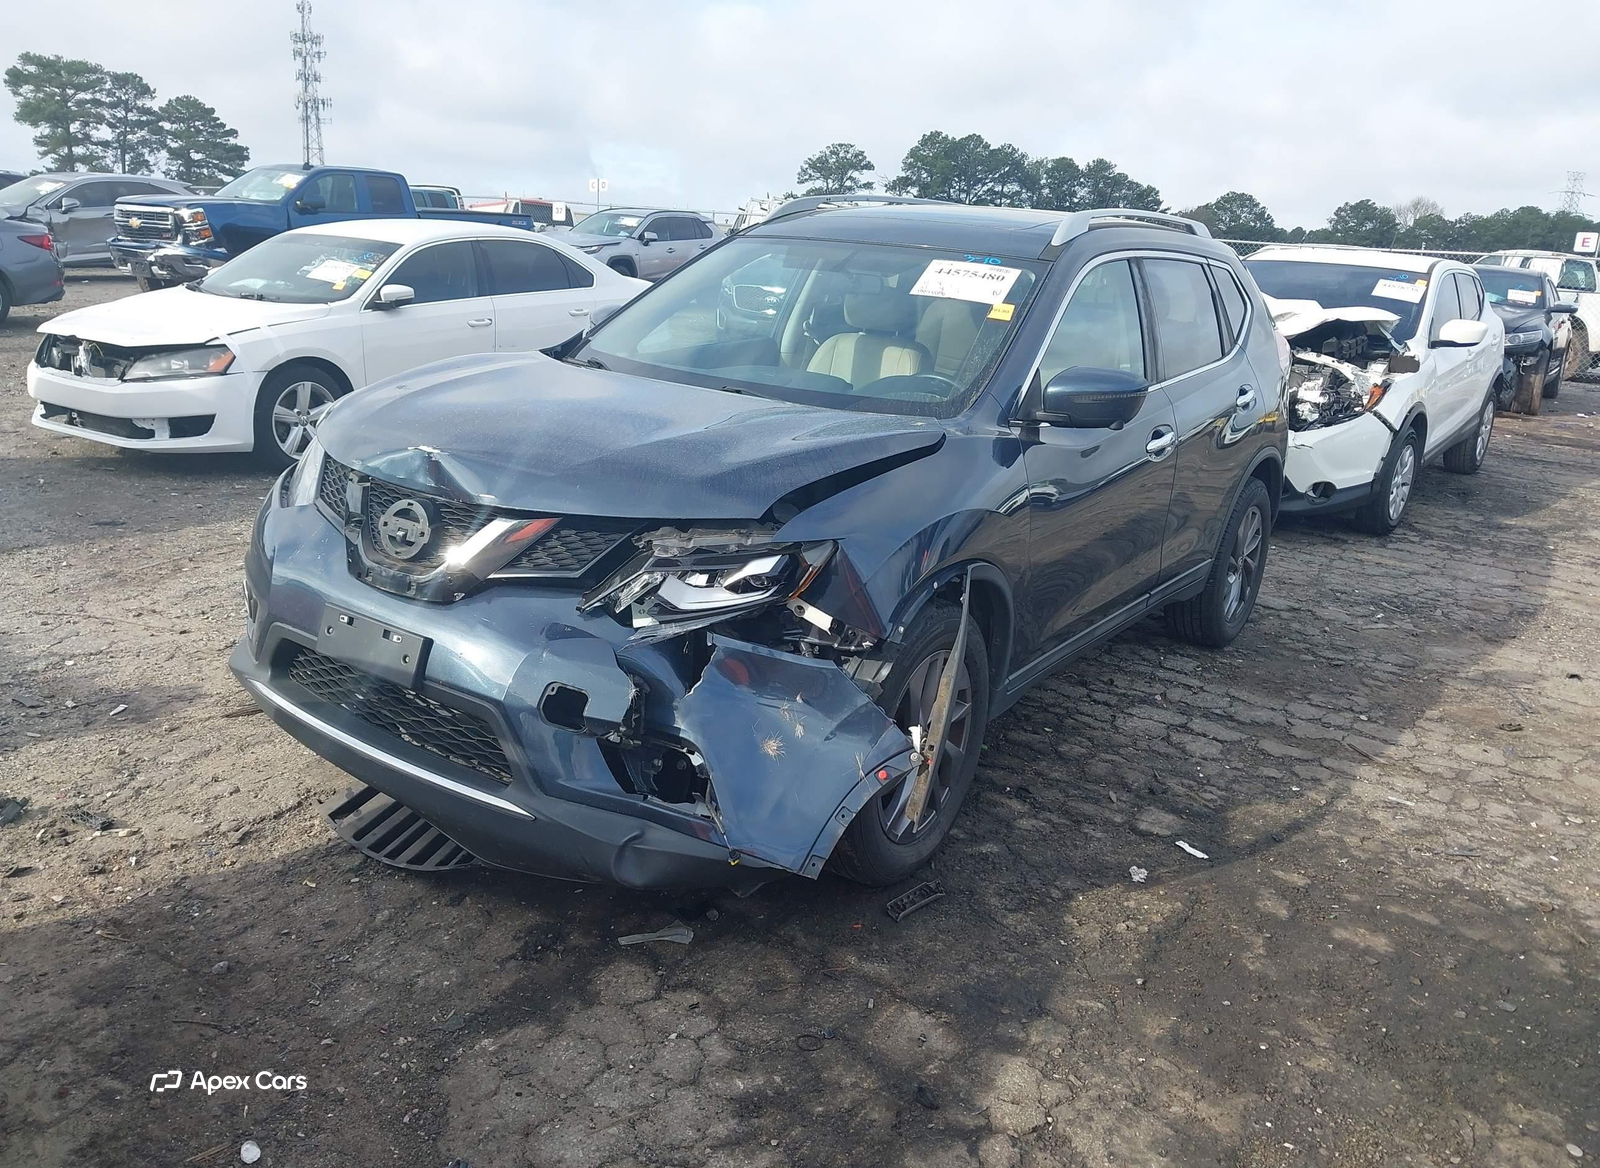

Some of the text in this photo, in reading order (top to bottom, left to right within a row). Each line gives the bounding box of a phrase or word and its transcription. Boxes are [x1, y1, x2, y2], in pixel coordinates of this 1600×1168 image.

[555, 207, 563, 215] 37
[1581, 237, 1591, 248] E
[934, 267, 1006, 282] 44575480
